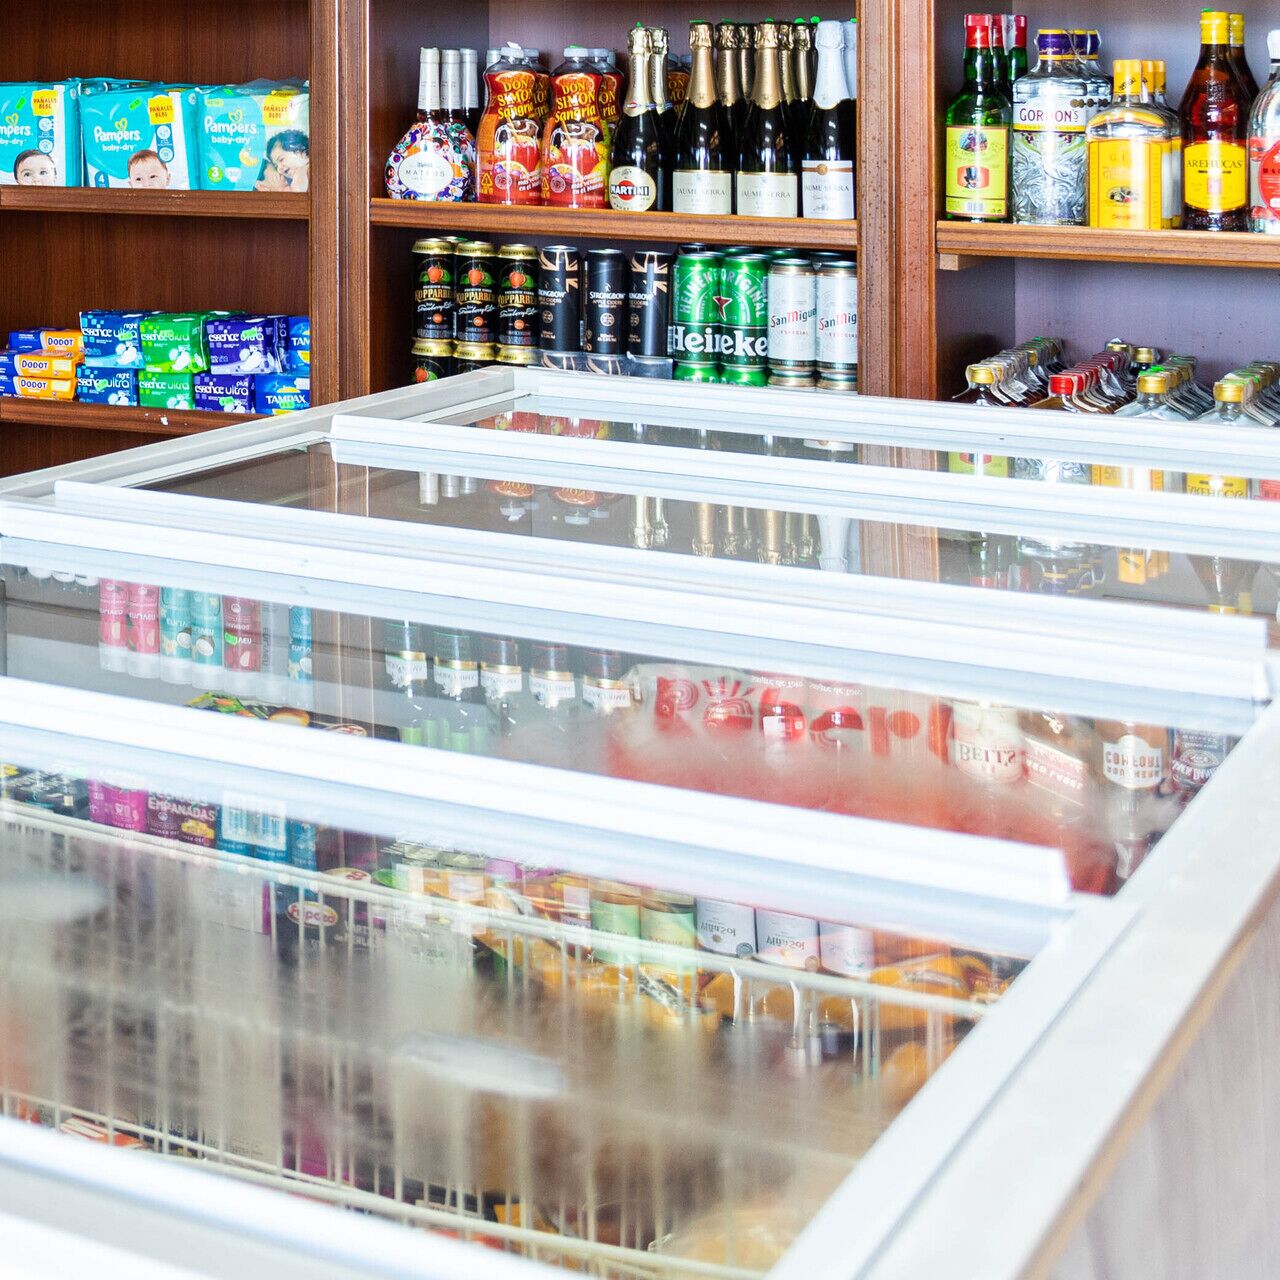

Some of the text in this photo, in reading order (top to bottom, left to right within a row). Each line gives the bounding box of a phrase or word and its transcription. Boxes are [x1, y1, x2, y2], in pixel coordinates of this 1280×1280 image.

[504, 81, 527, 91] DON
[562, 83, 585, 94] DON
[204, 115, 258, 136] Pampers
[94, 125, 141, 144] Pampers
[211, 135, 250, 145] baby-dry
[102, 143, 134, 153] baby-dry
[610, 185, 649, 197] MARTINI
[590, 291, 626, 300] STRONGBOW
[47, 337, 74, 348] DODOT
[21, 360, 49, 371] DODOT
[20, 379, 48, 391] DODOT
[225, 384, 249, 397] ultra
[265, 395, 306, 405] TAMPAX
